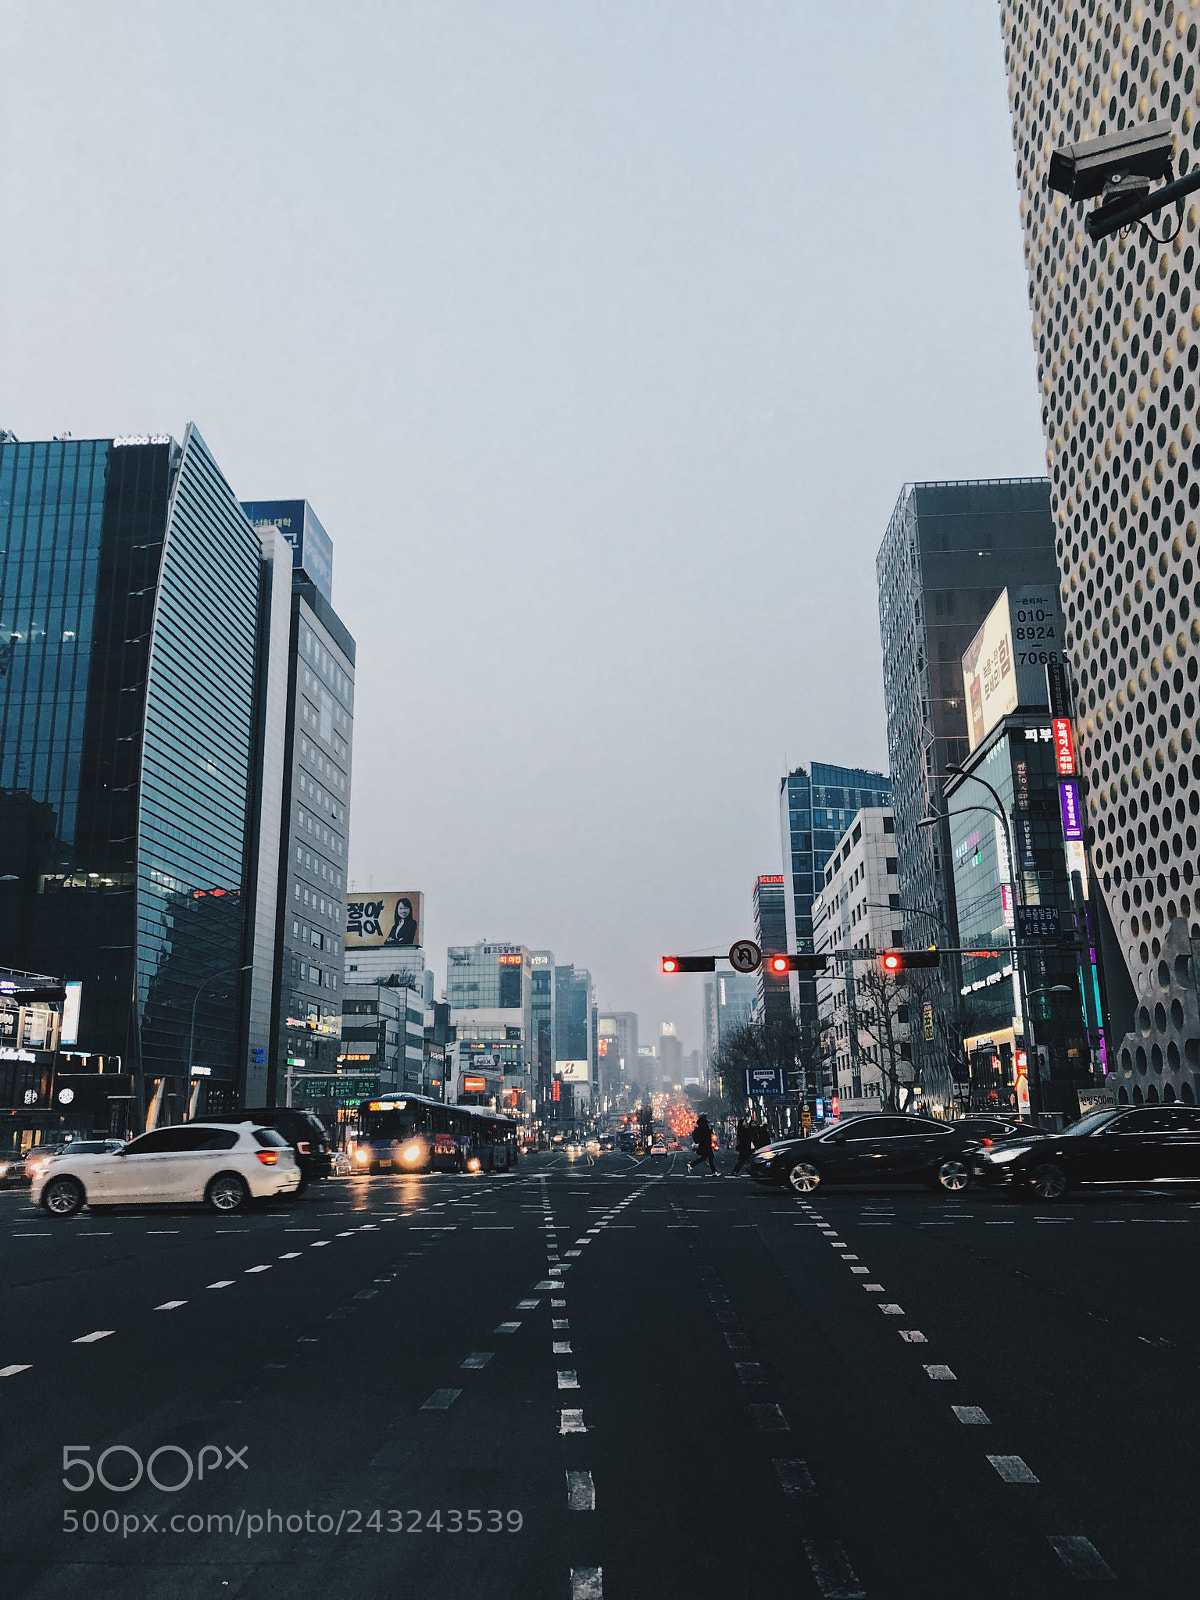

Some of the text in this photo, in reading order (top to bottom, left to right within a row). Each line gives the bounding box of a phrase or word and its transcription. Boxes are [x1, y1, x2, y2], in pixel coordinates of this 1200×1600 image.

[1018, 610, 1053, 622] 010-
[1017, 627, 1055, 640] 8924
[1018, 651, 1058, 664] 7066
[1024, 923, 1056, 935] 신호준수
